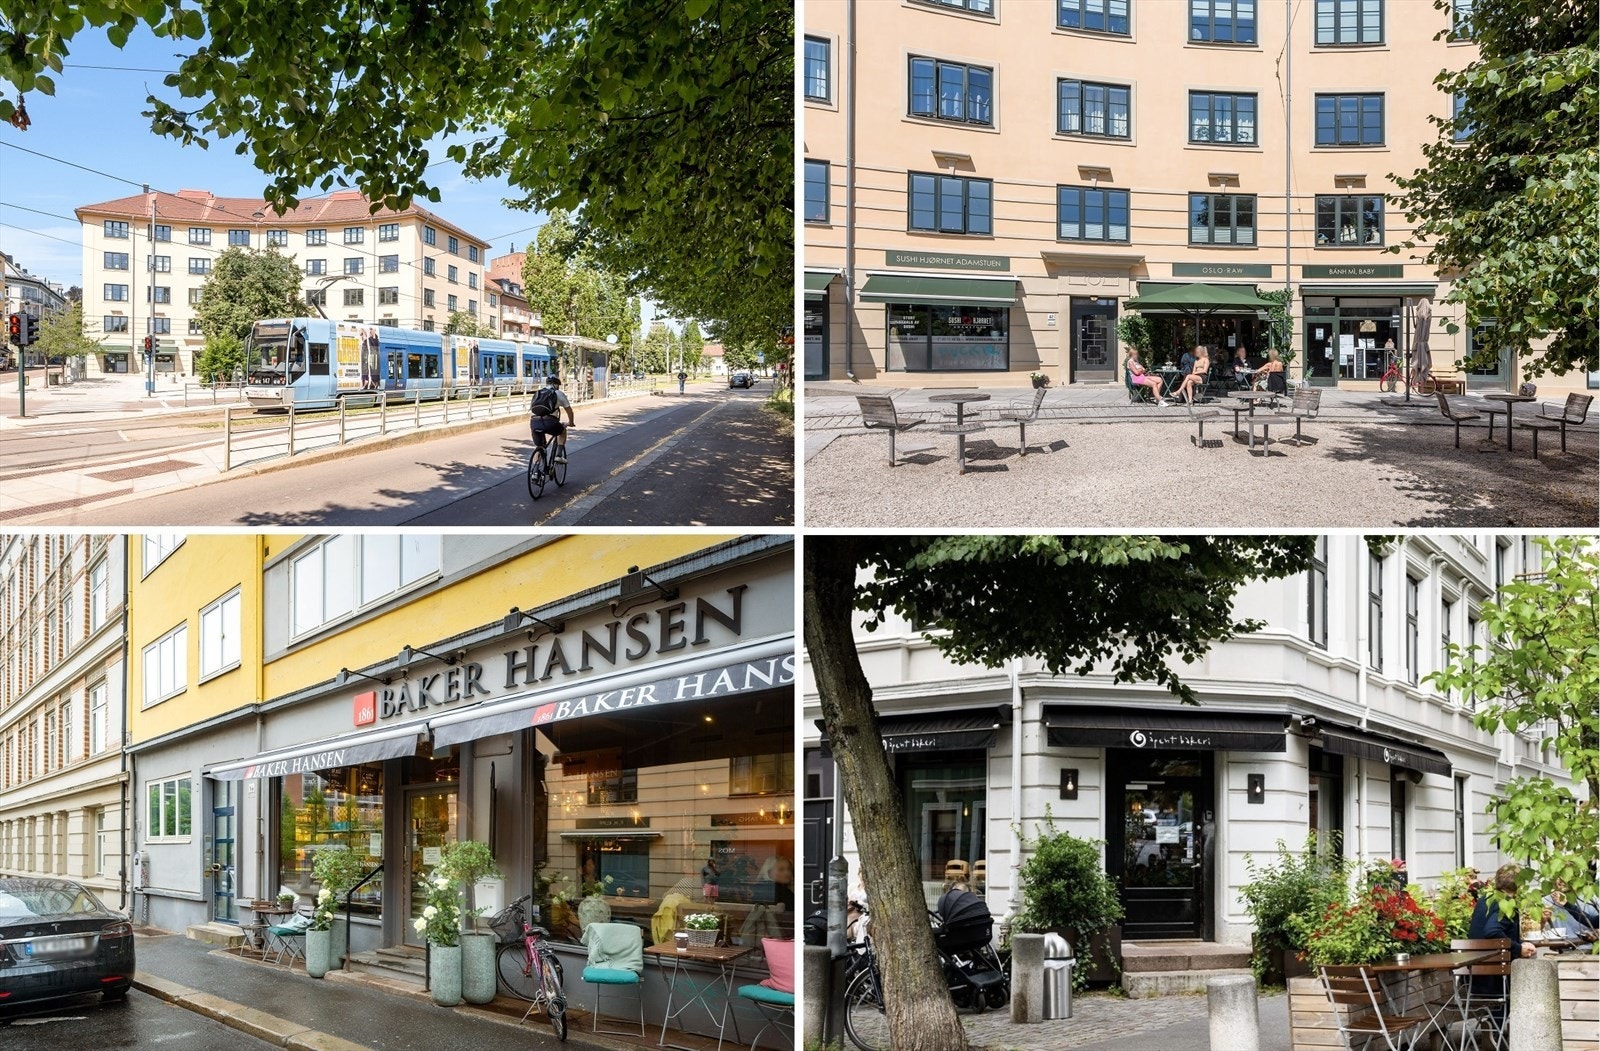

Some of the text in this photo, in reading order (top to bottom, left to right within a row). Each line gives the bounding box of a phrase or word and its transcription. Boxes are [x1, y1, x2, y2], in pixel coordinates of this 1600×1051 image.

[896, 254, 1002, 268] SUSHI HJØRNET ADAMSTUEN
[948, 316, 962, 324] SUSHI
[378, 583, 749, 720] BAKER HANSEN
[537, 712, 554, 723] 1861
[554, 684, 658, 720] BAKER
[358, 707, 374, 723] 1861
[253, 761, 288, 778] BAKER
[292, 749, 345, 773] HANSEN
